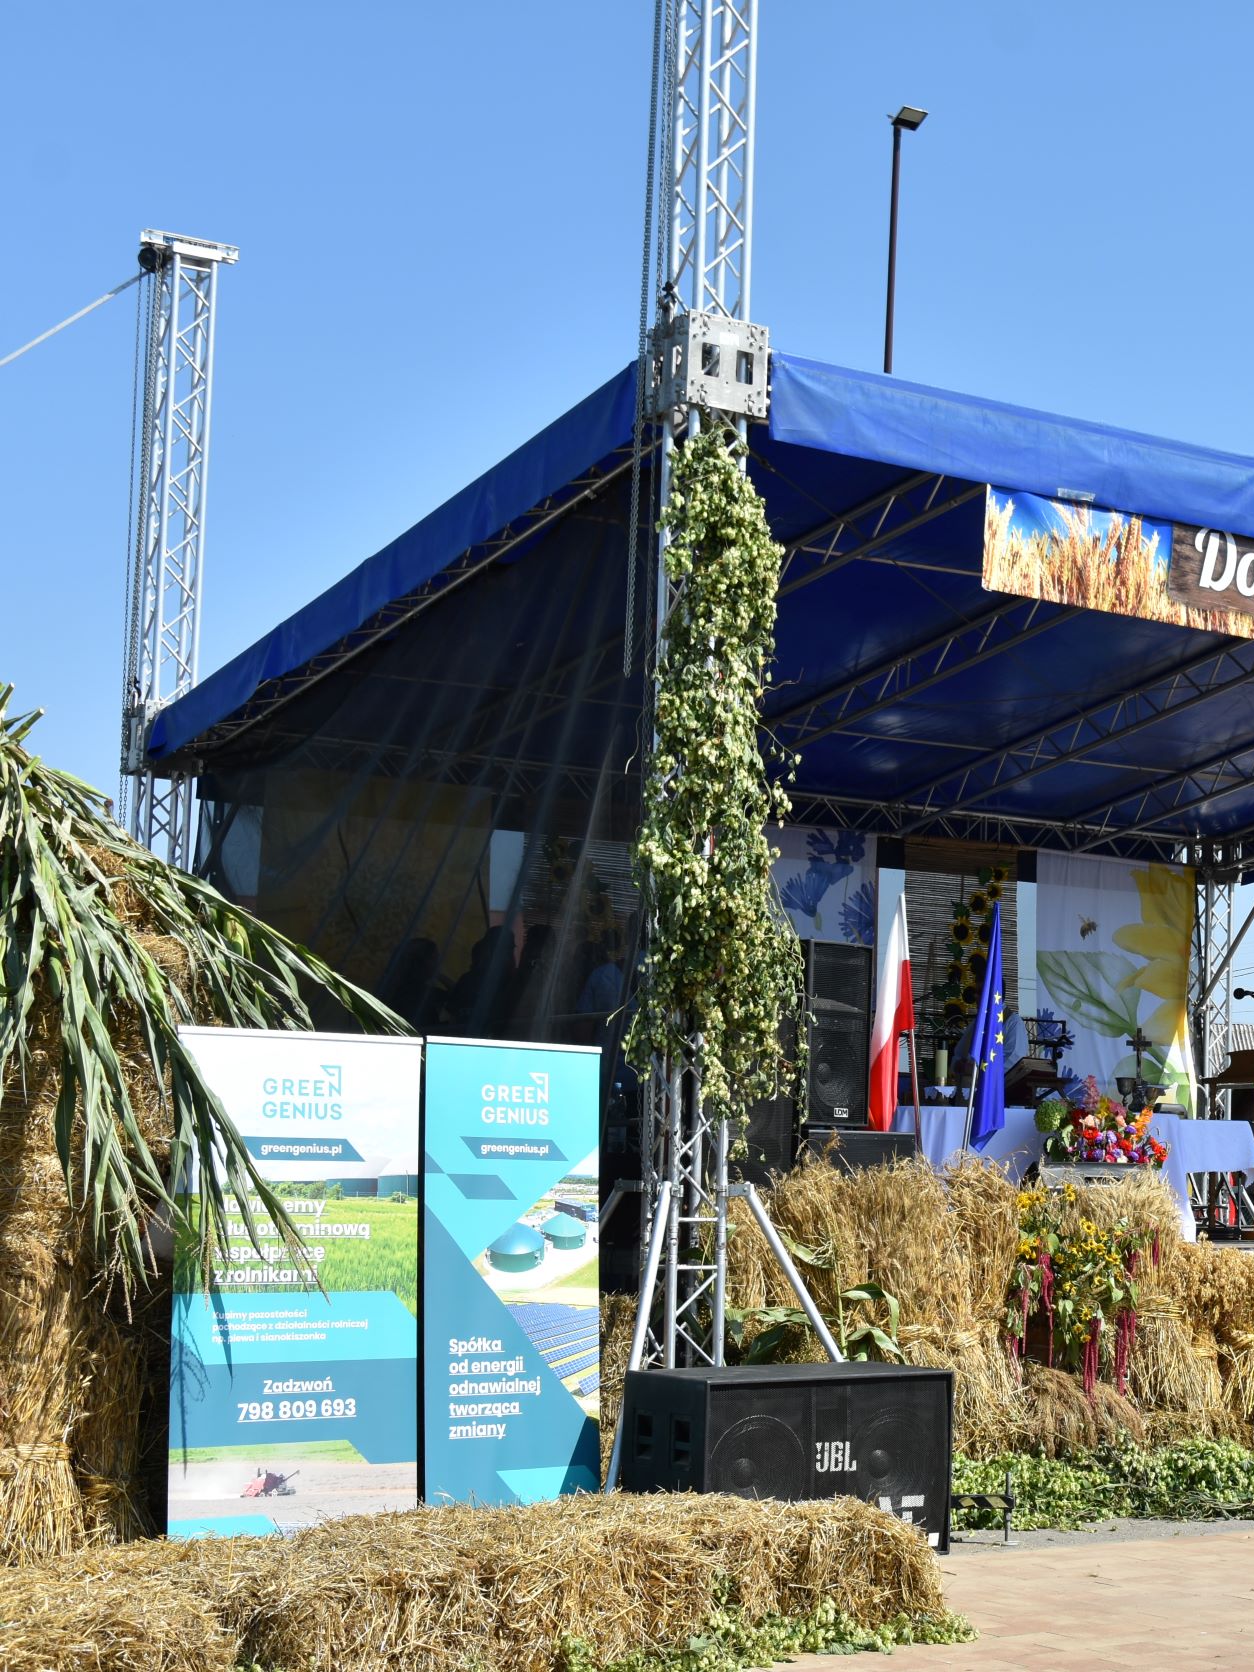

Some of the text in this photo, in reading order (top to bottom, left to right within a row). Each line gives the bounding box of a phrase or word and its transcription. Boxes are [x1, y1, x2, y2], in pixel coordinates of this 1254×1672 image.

[263, 1069, 342, 1097] GREEN
[481, 1075, 549, 1104] GREEN
[262, 1101, 342, 1120] GENIUS
[481, 1106, 549, 1126] GENIUS
[261, 1143, 342, 1157] greengenius.pl
[481, 1144, 549, 1157] greengenius.pl
[214, 1265, 318, 1283] z rolnikami
[212, 1310, 247, 1321] Kupimy
[212, 1322, 267, 1333] pochodzące
[449, 1336, 502, 1357] Spółka
[449, 1356, 524, 1376] od energii
[263, 1376, 333, 1393] Zadzwoń
[449, 1376, 541, 1395] odnawialnej
[237, 1398, 357, 1421] 798 809 693
[449, 1402, 520, 1417] tworząca
[449, 1420, 507, 1439] zmiany
[815, 1441, 857, 1472] JBL
